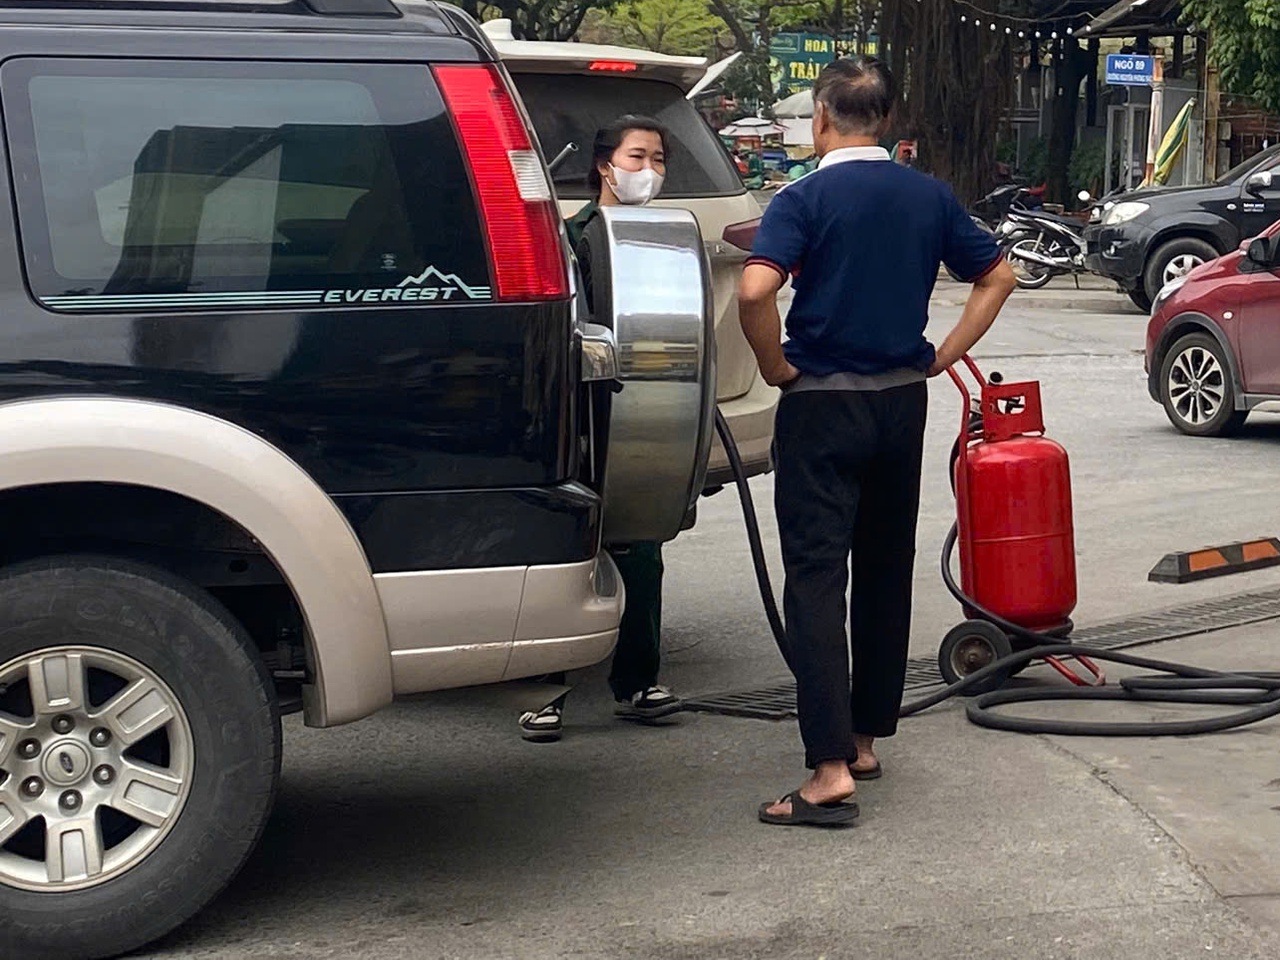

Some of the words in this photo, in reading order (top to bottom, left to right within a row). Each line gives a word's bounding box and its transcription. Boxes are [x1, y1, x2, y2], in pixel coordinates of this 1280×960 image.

[804, 39, 828, 53] HOA
[1114, 57, 1133, 70] NGÕ
[323, 287, 458, 303] EVEREST
